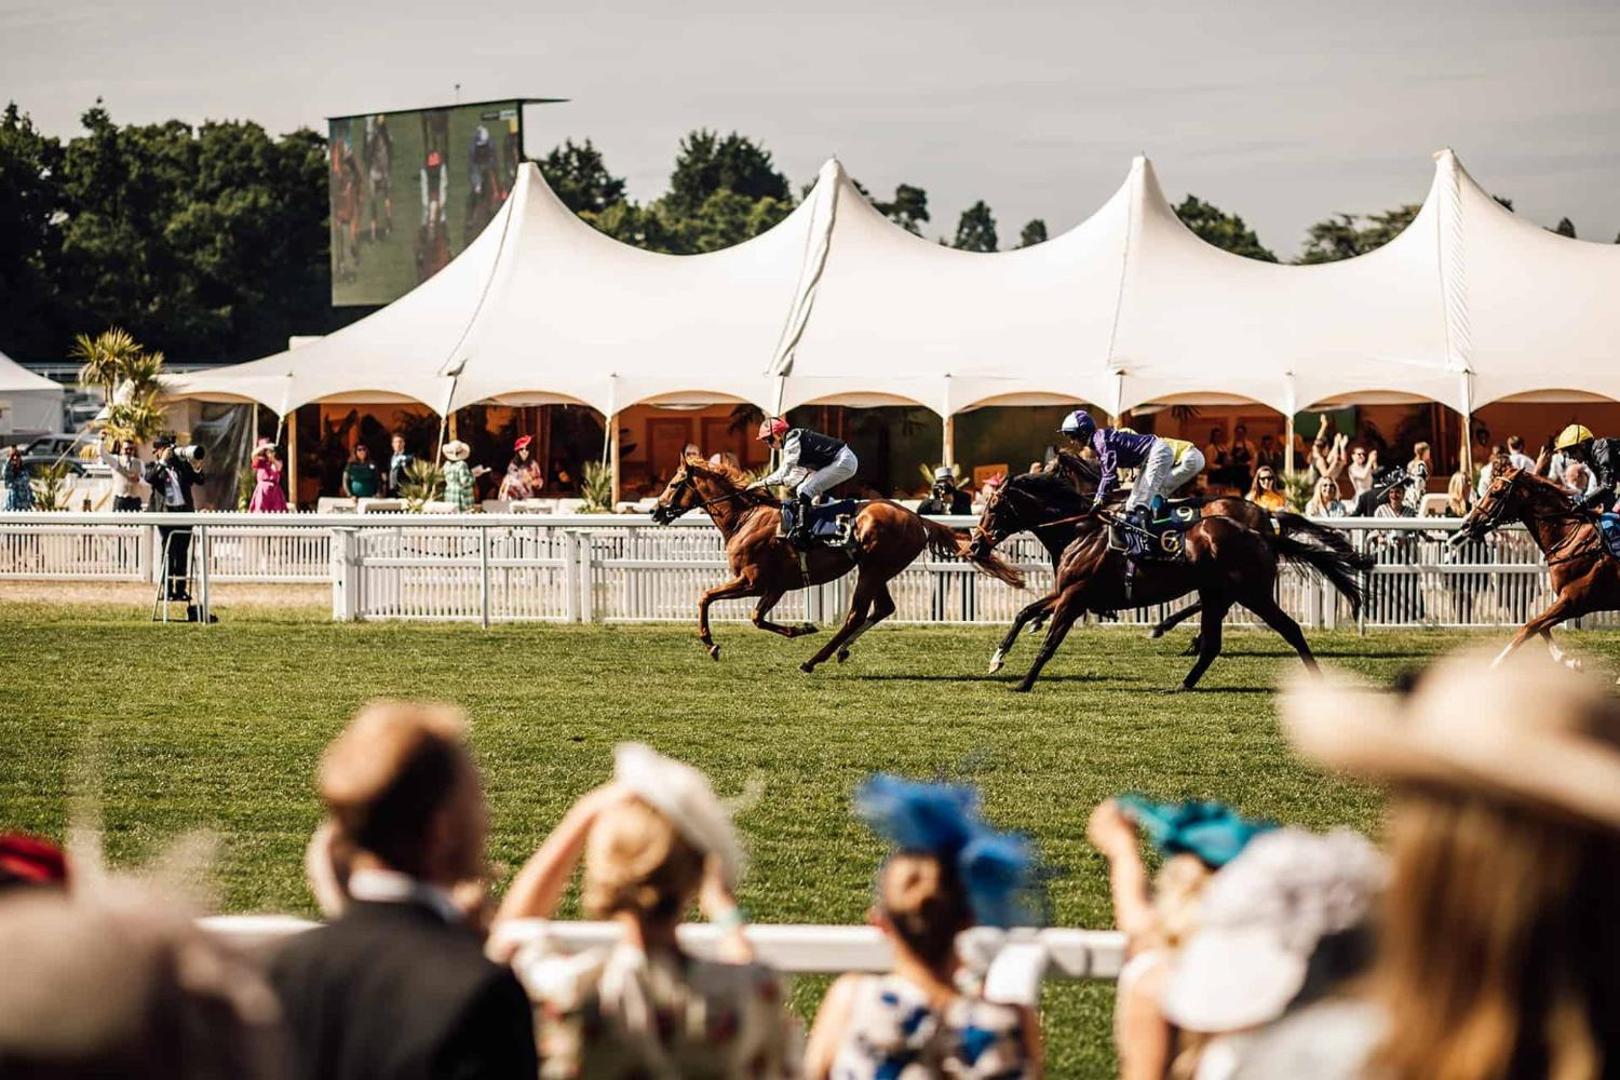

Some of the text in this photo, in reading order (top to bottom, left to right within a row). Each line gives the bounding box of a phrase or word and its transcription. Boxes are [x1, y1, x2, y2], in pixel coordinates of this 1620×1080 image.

[835, 513, 851, 538] 5
[1176, 506, 1193, 522] 9
[1161, 529, 1179, 553] 6
